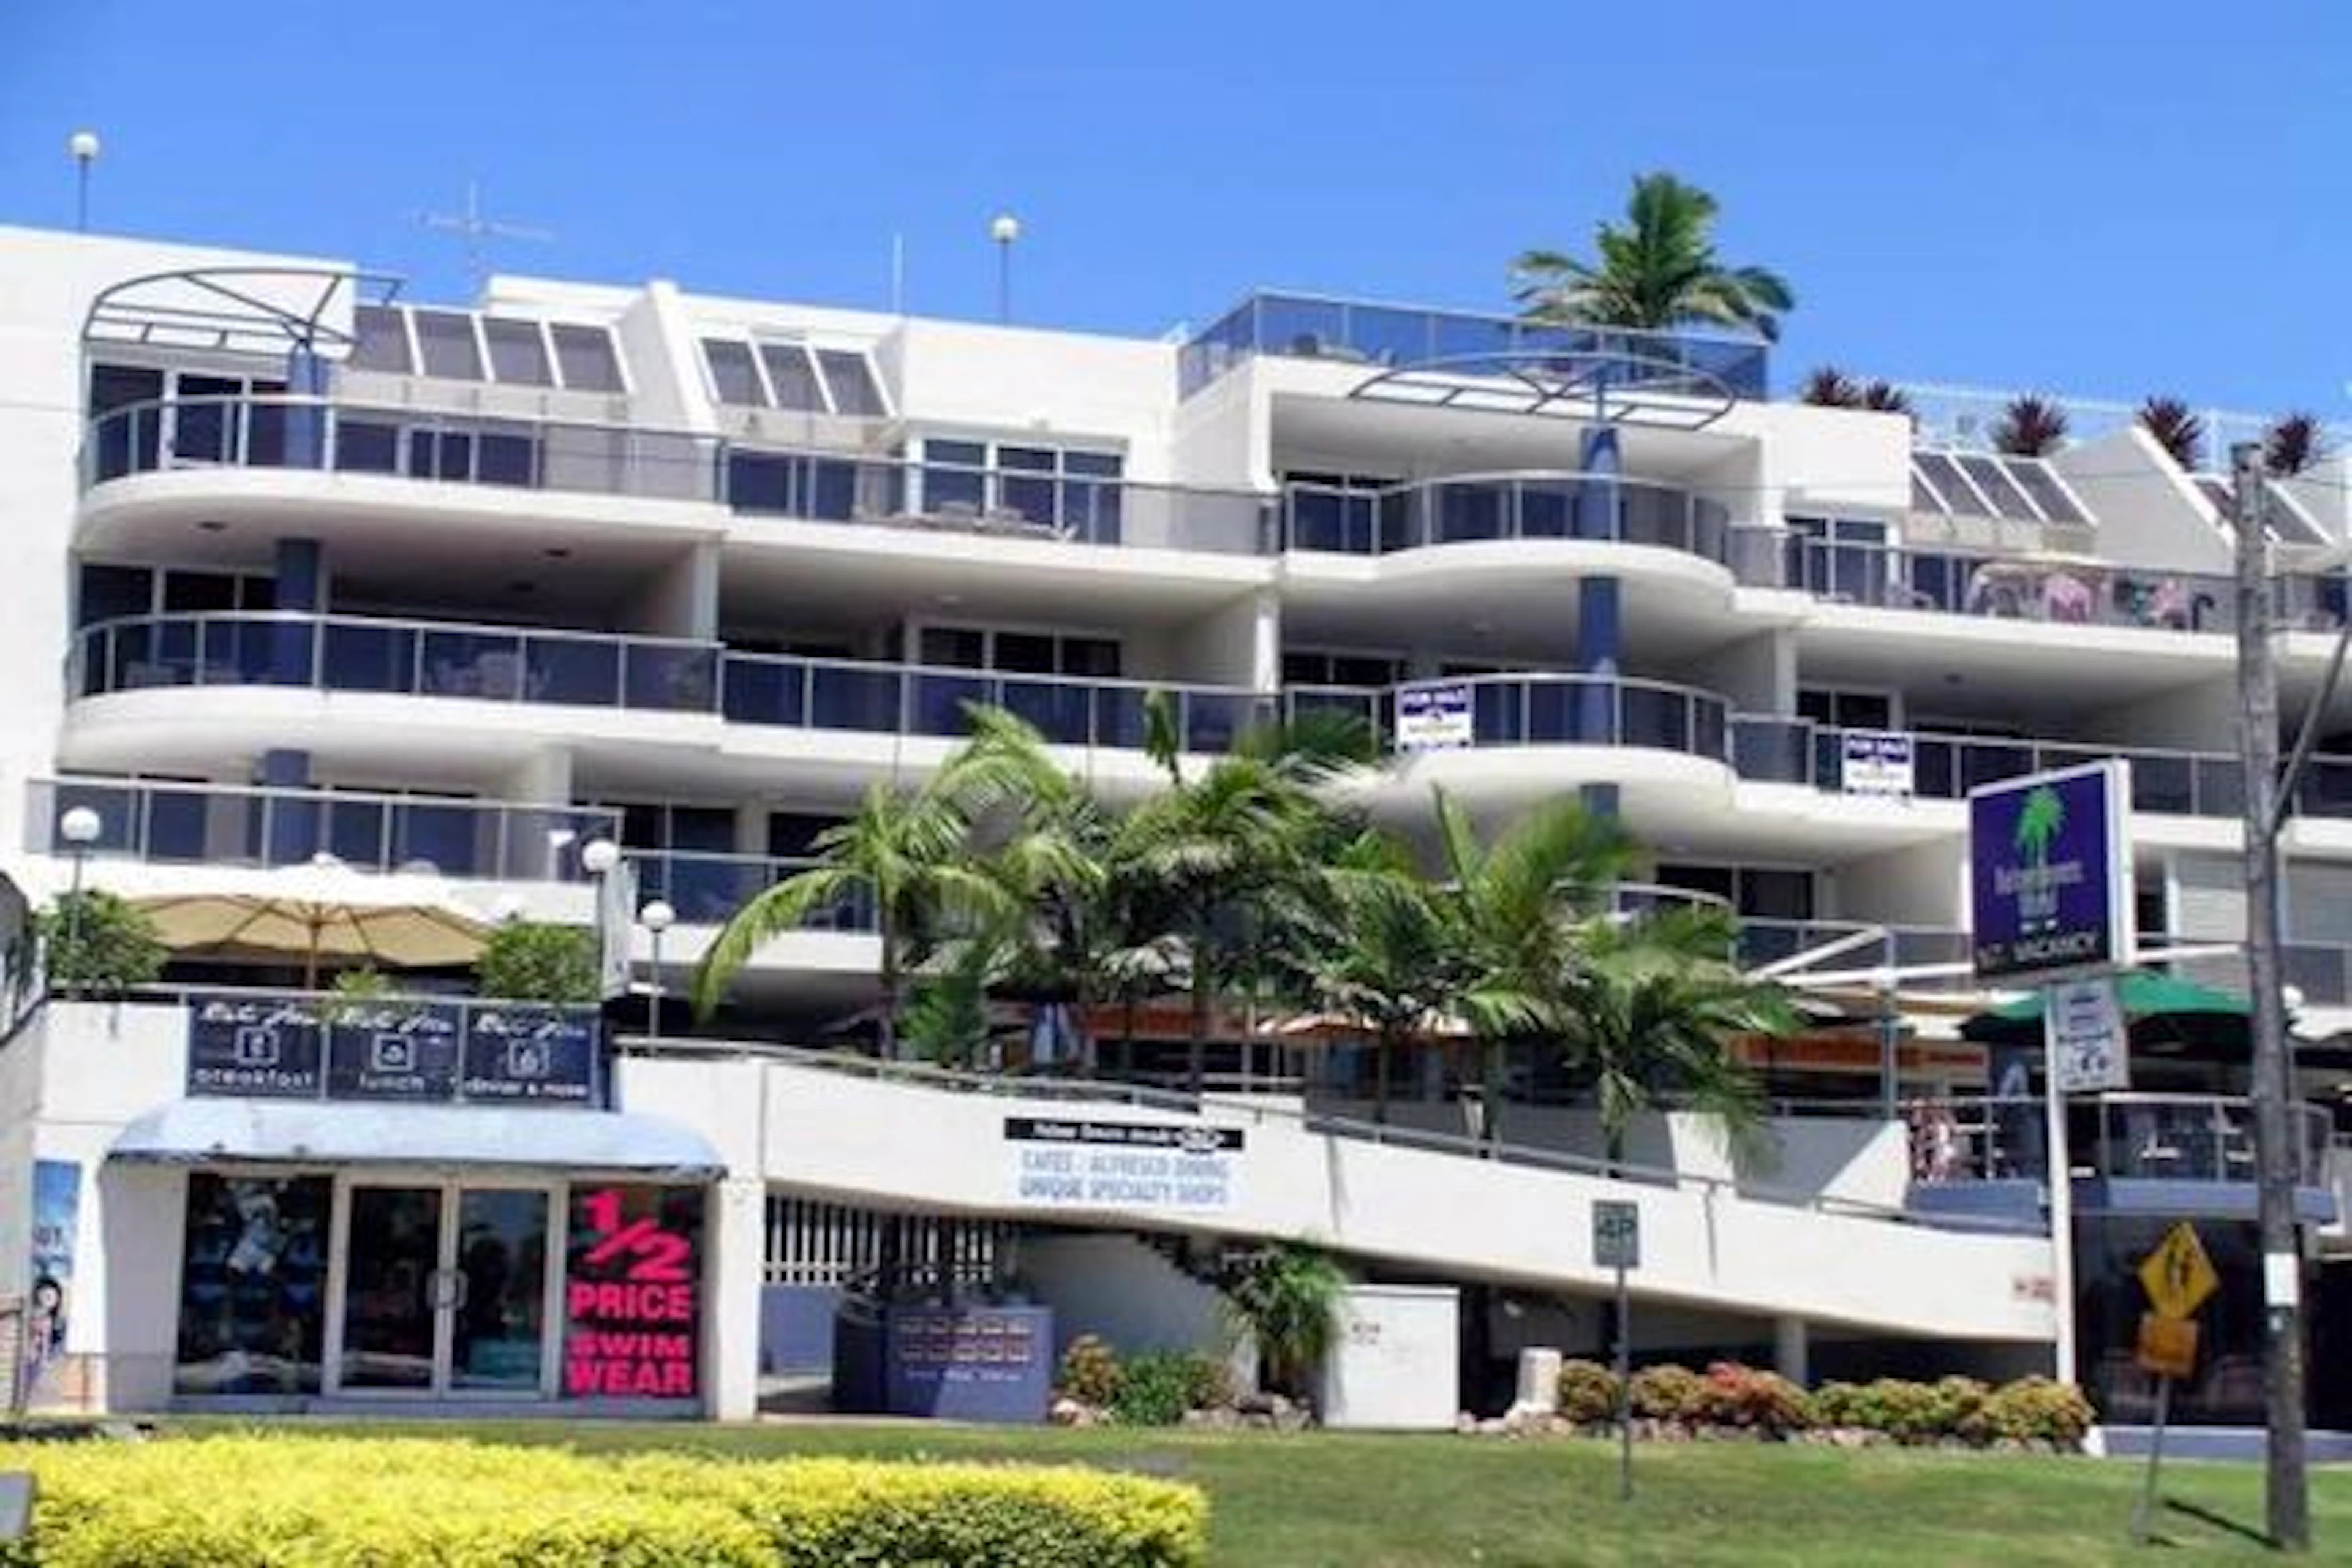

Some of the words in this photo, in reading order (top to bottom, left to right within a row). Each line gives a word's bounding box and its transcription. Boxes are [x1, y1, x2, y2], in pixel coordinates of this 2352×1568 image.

[569, 1281, 691, 1320] PRICE
[568, 1332, 690, 1359] SWIM
[568, 1359, 692, 1395] WEAR
